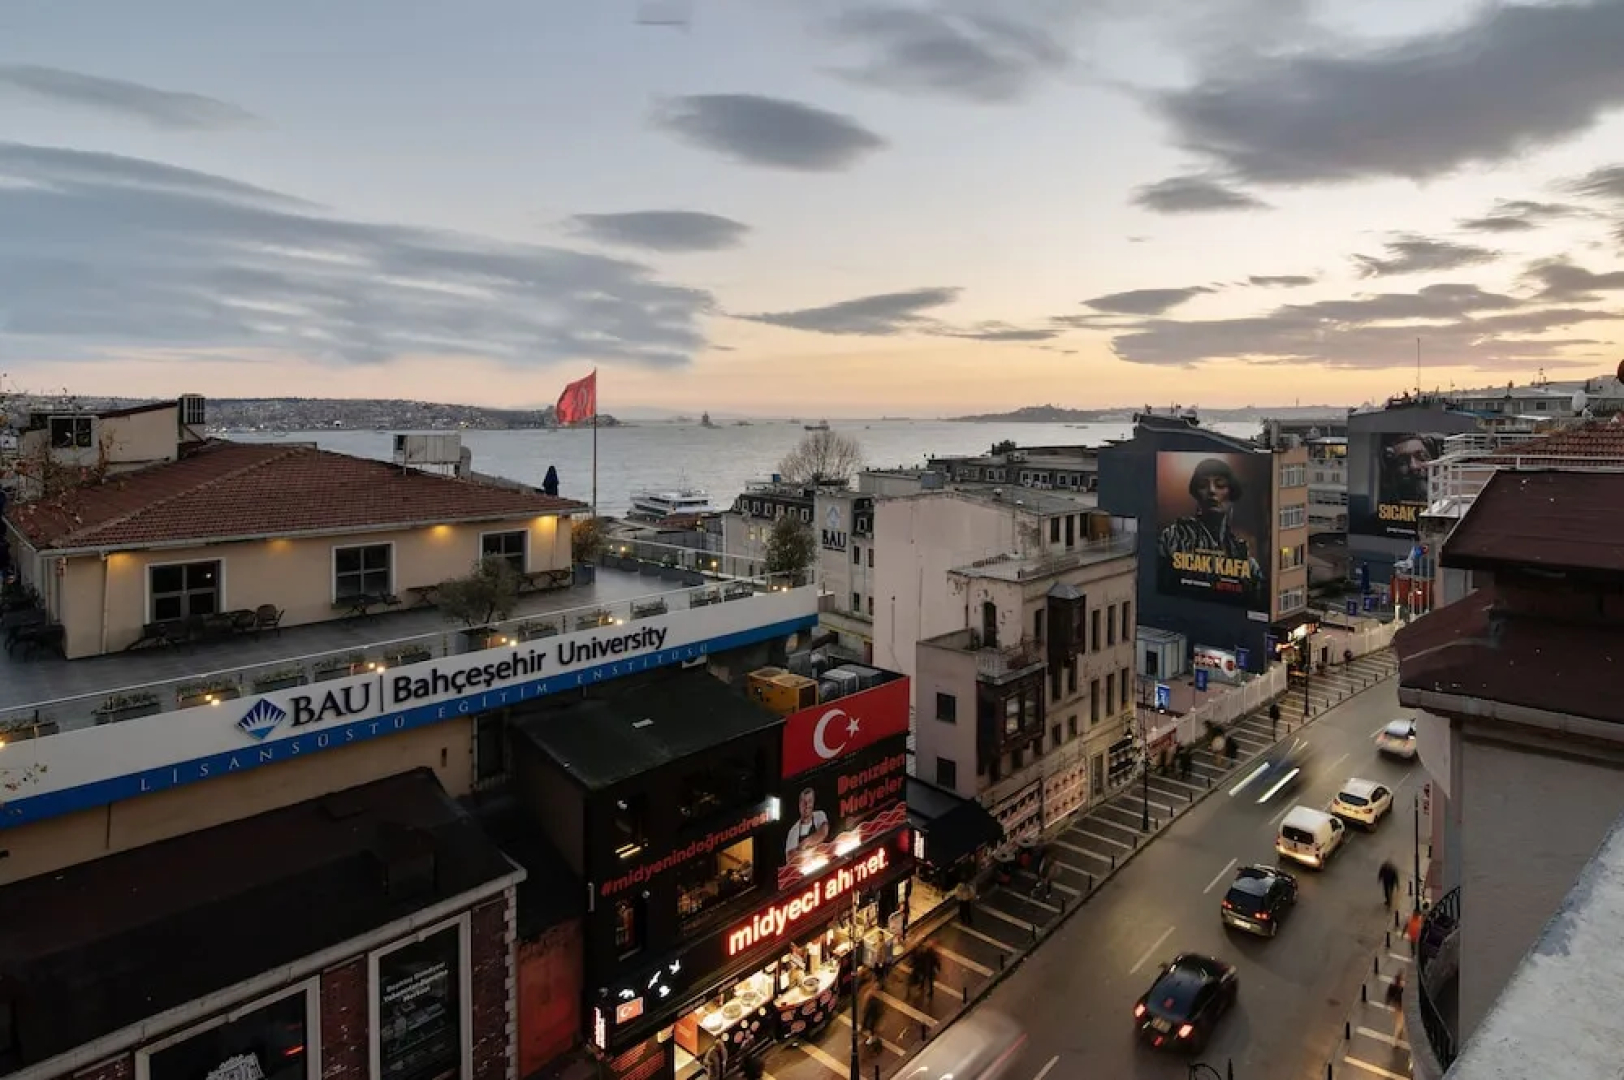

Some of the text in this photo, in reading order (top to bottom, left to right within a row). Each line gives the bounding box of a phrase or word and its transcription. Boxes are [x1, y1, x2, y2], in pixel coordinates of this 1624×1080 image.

[822, 528, 847, 548] BAU
[1172, 551, 1251, 579] SICAK KAFA
[289, 626, 668, 728] BAU Bahçeşehir University
[840, 776, 904, 818] Midyeler
[729, 882, 821, 956] midyeci
